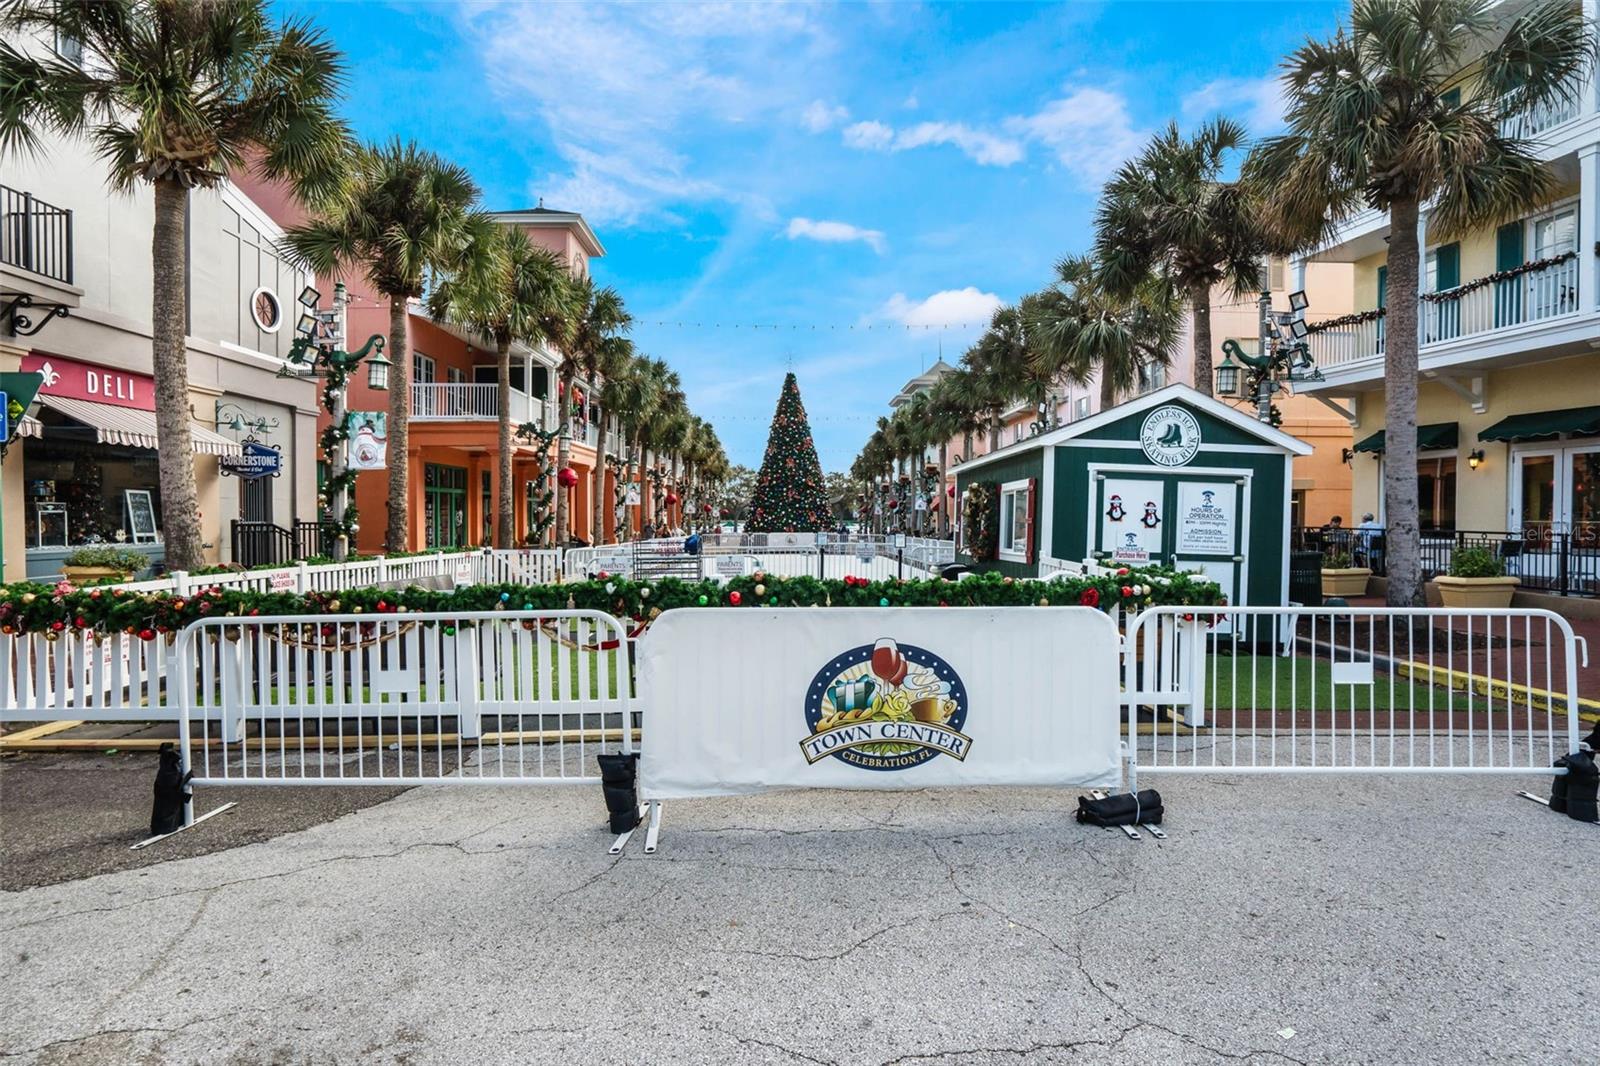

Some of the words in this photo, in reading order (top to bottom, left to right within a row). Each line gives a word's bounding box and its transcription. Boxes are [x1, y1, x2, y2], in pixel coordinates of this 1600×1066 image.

[87, 370, 134, 400] DELI
[1146, 410, 1182, 431] ENDLESS
[1182, 416, 1195, 431] ICE
[222, 455, 277, 467] CORNERSTONE
[1145, 436, 1179, 463] SKATING
[1180, 436, 1197, 460] RINK
[807, 724, 872, 756] TOWN
[880, 723, 963, 755] CENTER
[841, 751, 919, 768] CELEBRATION,
[919, 750, 933, 761] FL
